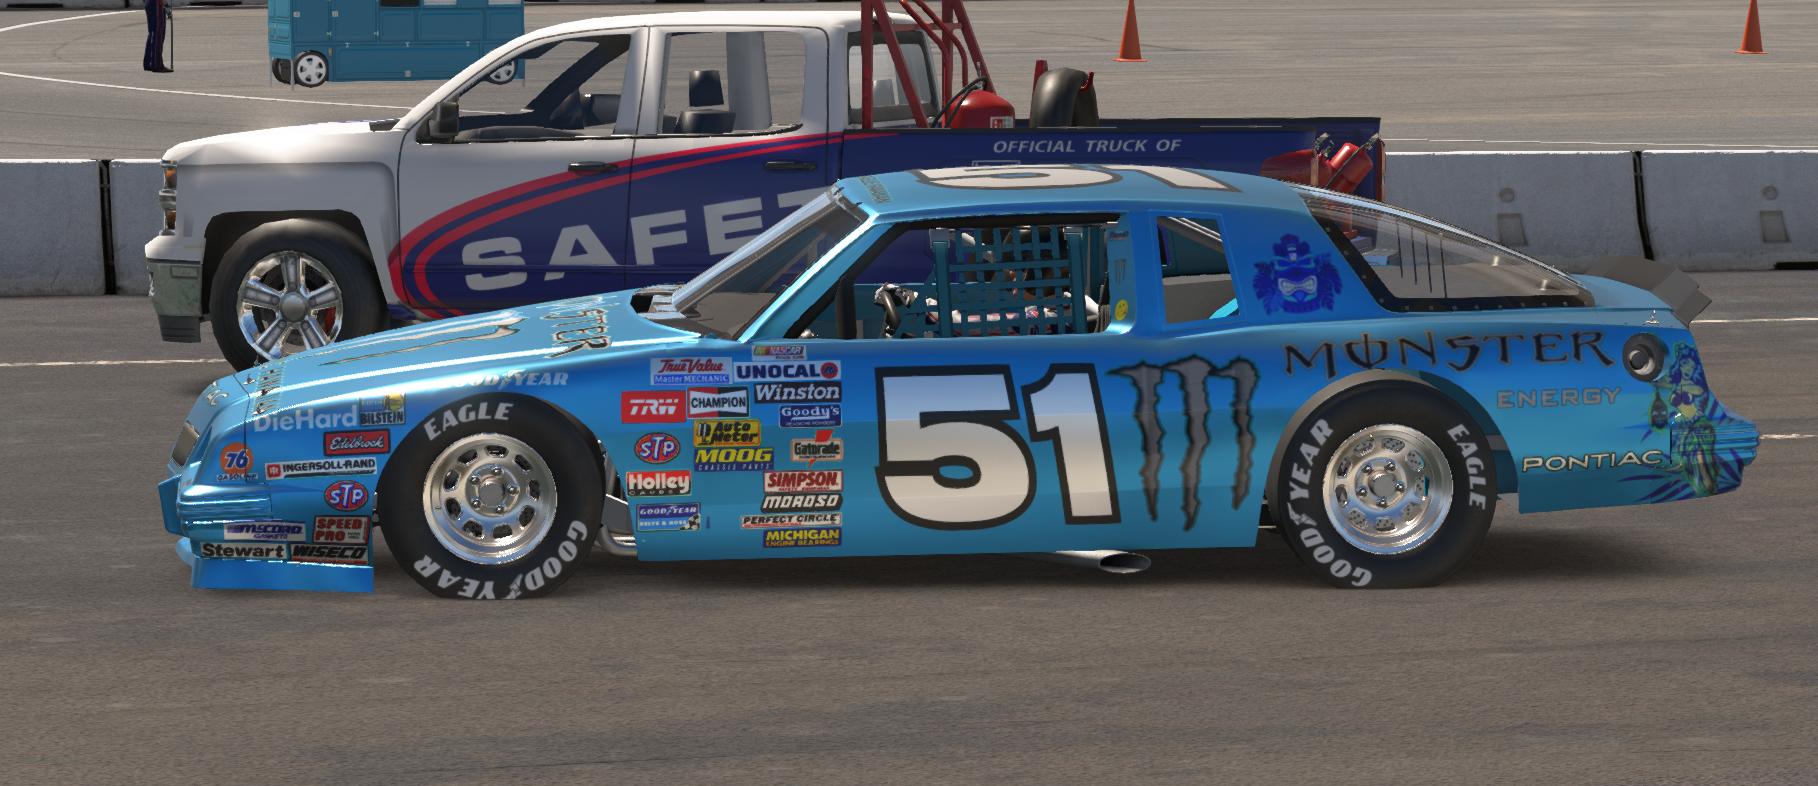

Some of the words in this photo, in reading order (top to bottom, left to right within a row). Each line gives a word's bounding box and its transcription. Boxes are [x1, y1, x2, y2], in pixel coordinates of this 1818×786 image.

[993, 140, 1075, 153] OFFICIAL
[1086, 139, 1148, 152] TRUCK
[1156, 139, 1182, 152] OF
[654, 375, 684, 384] Master
[684, 374, 730, 384] MECHANIC
[736, 364, 821, 379] UNOCAL
[755, 383, 840, 401] Winston
[1496, 387, 1622, 410] ENERGY
[629, 399, 680, 416] TRW
[690, 397, 747, 408] CHAMPION
[254, 403, 358, 433] DieHard
[360, 411, 405, 425] BILSTEIN
[781, 406, 840, 419] Goody's
[423, 402, 515, 441] EAGLE
[713, 422, 751, 433] Auto
[640, 436, 676, 459] STP
[794, 442, 841, 456] Gatorade
[874, 363, 1122, 531] 51
[224, 449, 249, 469] 76
[696, 448, 774, 463] MOOG
[1521, 449, 1665, 474] PONTIAC
[282, 459, 377, 473] INGERSOLL-RAND
[1446, 422, 1487, 511] EAGLE
[629, 471, 690, 494] Holley
[768, 471, 840, 487] SIMPSON
[329, 484, 365, 507] STP
[762, 494, 840, 510] MOROSO
[317, 518, 362, 529] SPEED
[743, 515, 794, 525] PERFECT
[796, 514, 838, 523] CIRCLE
[315, 530, 346, 541] PRO
[766, 529, 840, 541] MICHIGAN
[203, 543, 284, 558] Stewart
[293, 546, 366, 560] WISECO
